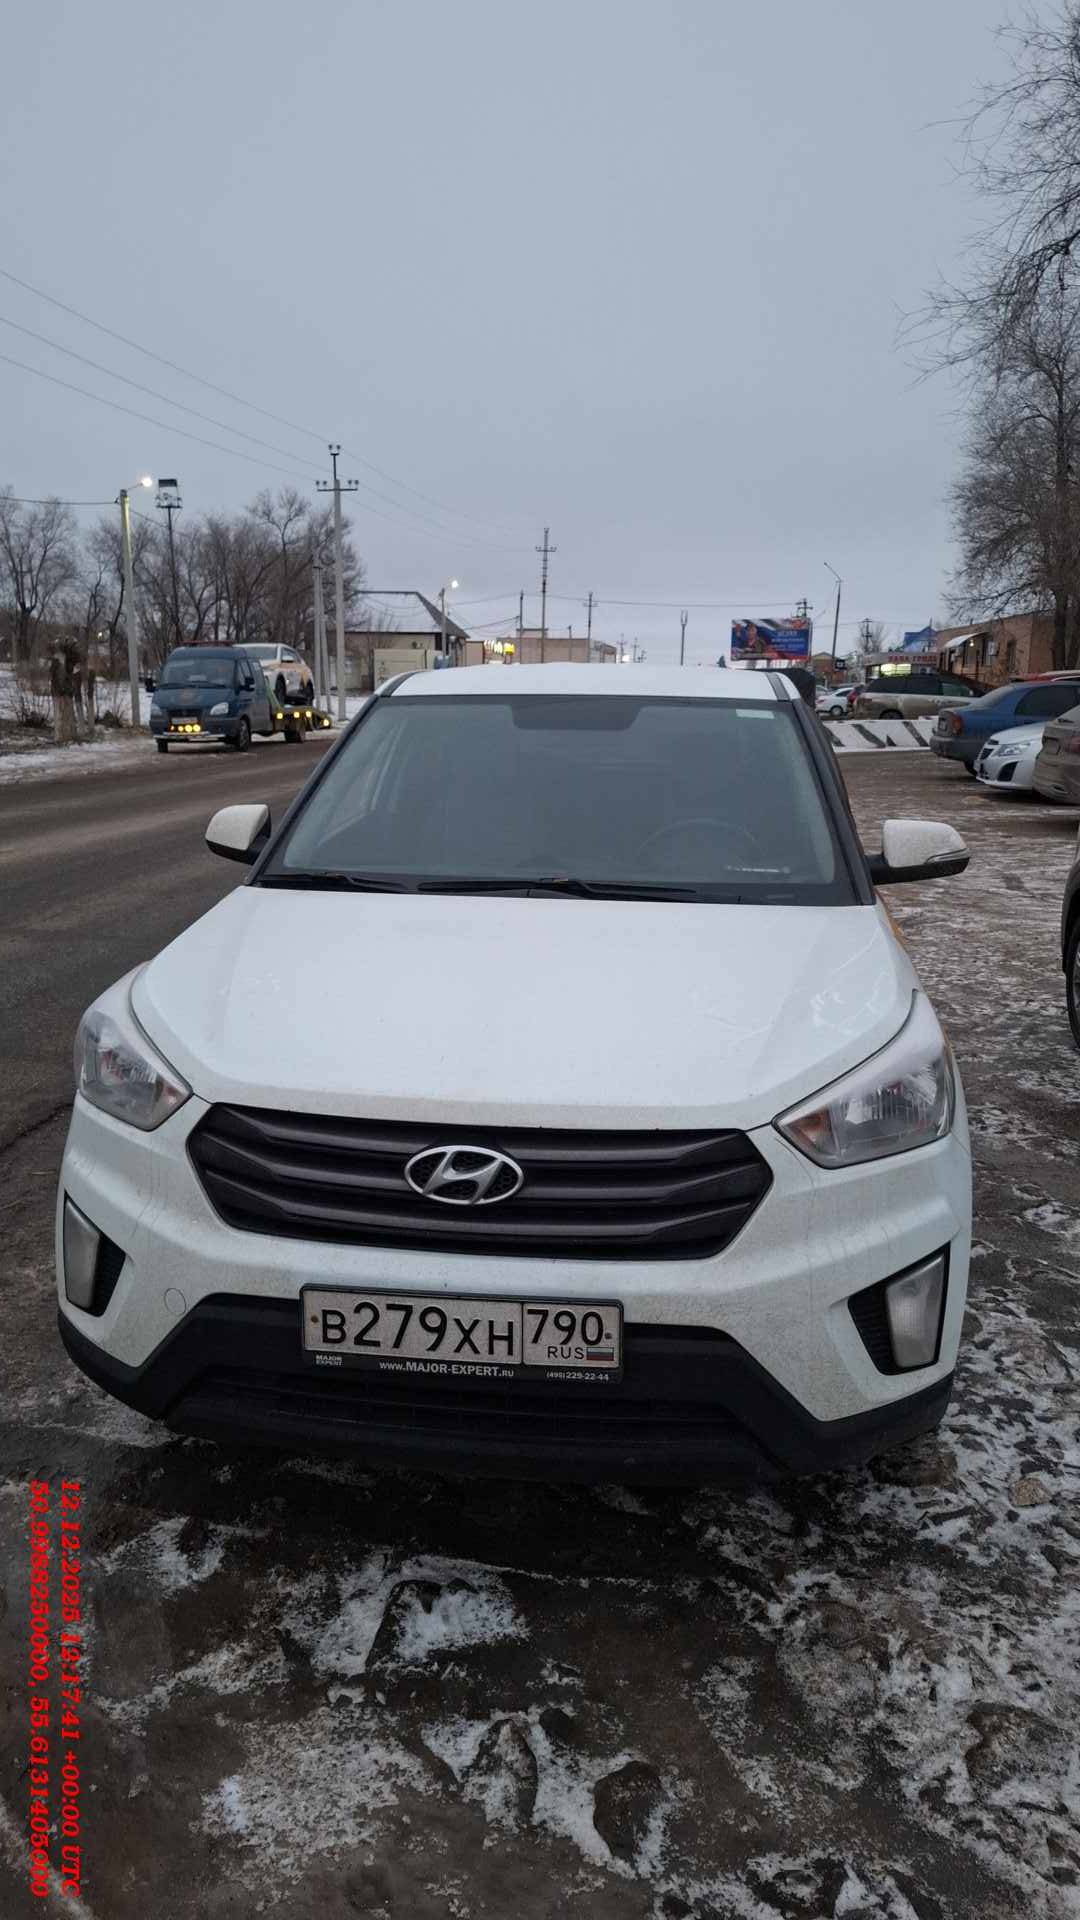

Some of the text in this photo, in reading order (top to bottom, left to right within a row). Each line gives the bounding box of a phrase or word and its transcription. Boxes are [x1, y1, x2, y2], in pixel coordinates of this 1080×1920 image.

[321, 1301, 604, 1356] В279ХН 790
[547, 1346, 585, 1360] RUS
